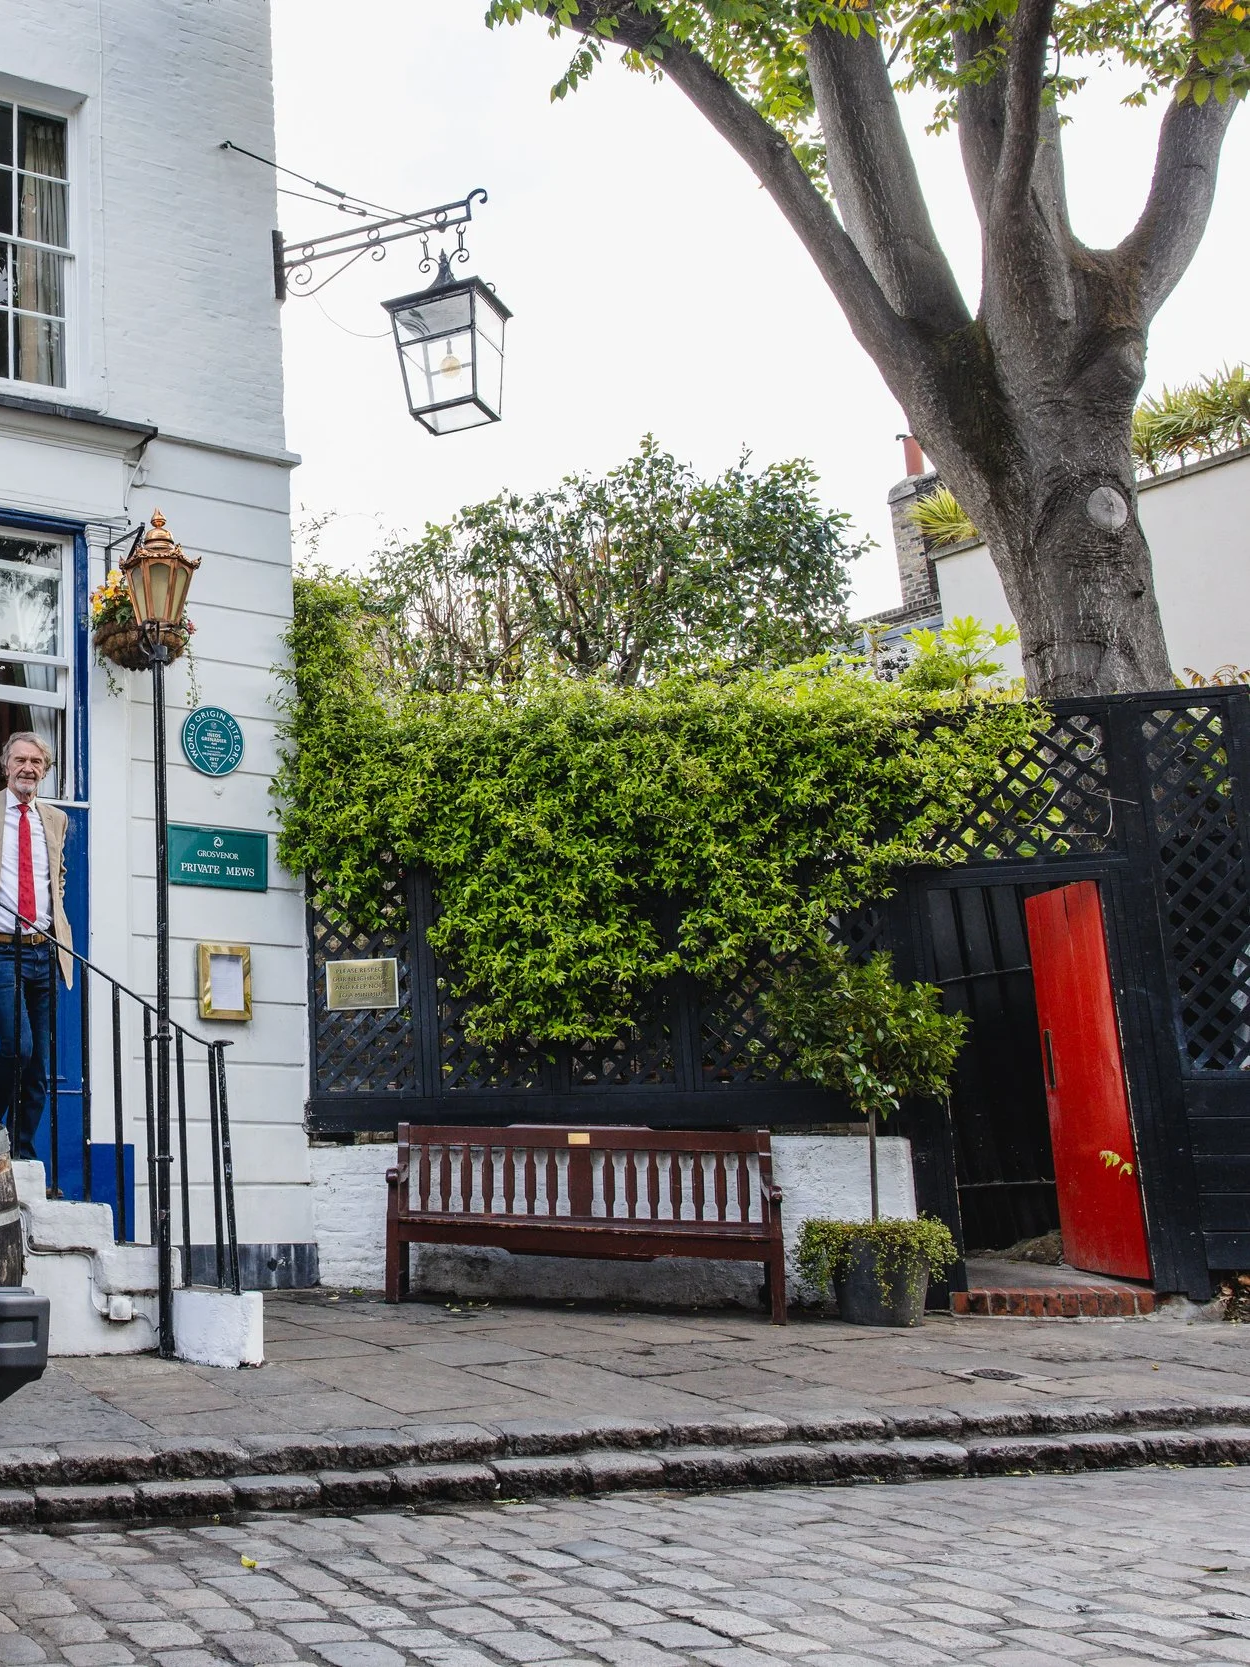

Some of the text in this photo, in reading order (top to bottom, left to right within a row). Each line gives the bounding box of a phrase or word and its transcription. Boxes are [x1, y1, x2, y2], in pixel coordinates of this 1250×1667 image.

[187, 723, 199, 759] WORLD
[195, 710, 226, 722] ORIGIN
[197, 849, 239, 860] GROSVENOR
[180, 862, 255, 877] PRIVATE MEWS
